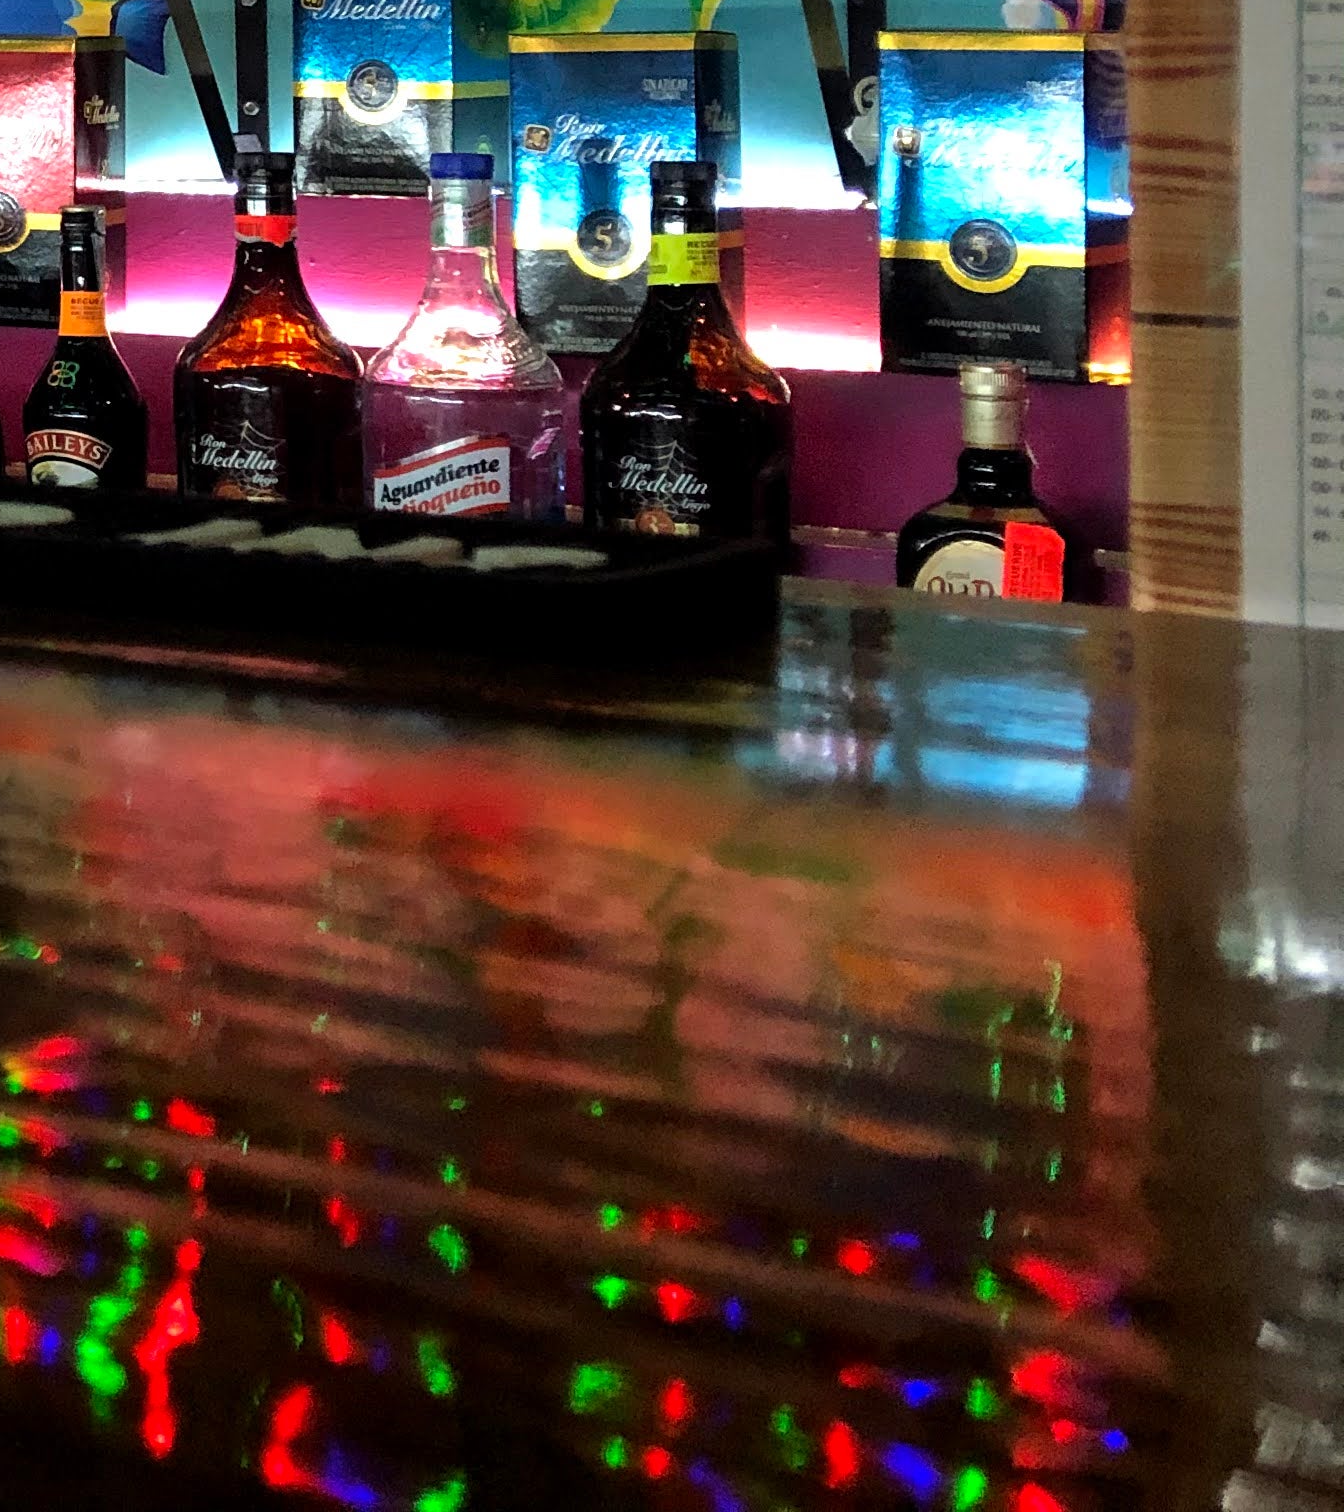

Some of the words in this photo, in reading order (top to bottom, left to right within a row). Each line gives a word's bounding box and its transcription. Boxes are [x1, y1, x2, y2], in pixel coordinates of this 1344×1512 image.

[556, 113, 606, 134] Ron
[594, 222, 612, 253] 5
[26, 434, 103, 461] BAILEYS
[199, 433, 227, 448] Ron
[618, 454, 652, 472] Ron
[380, 457, 501, 503] Aguardiente
